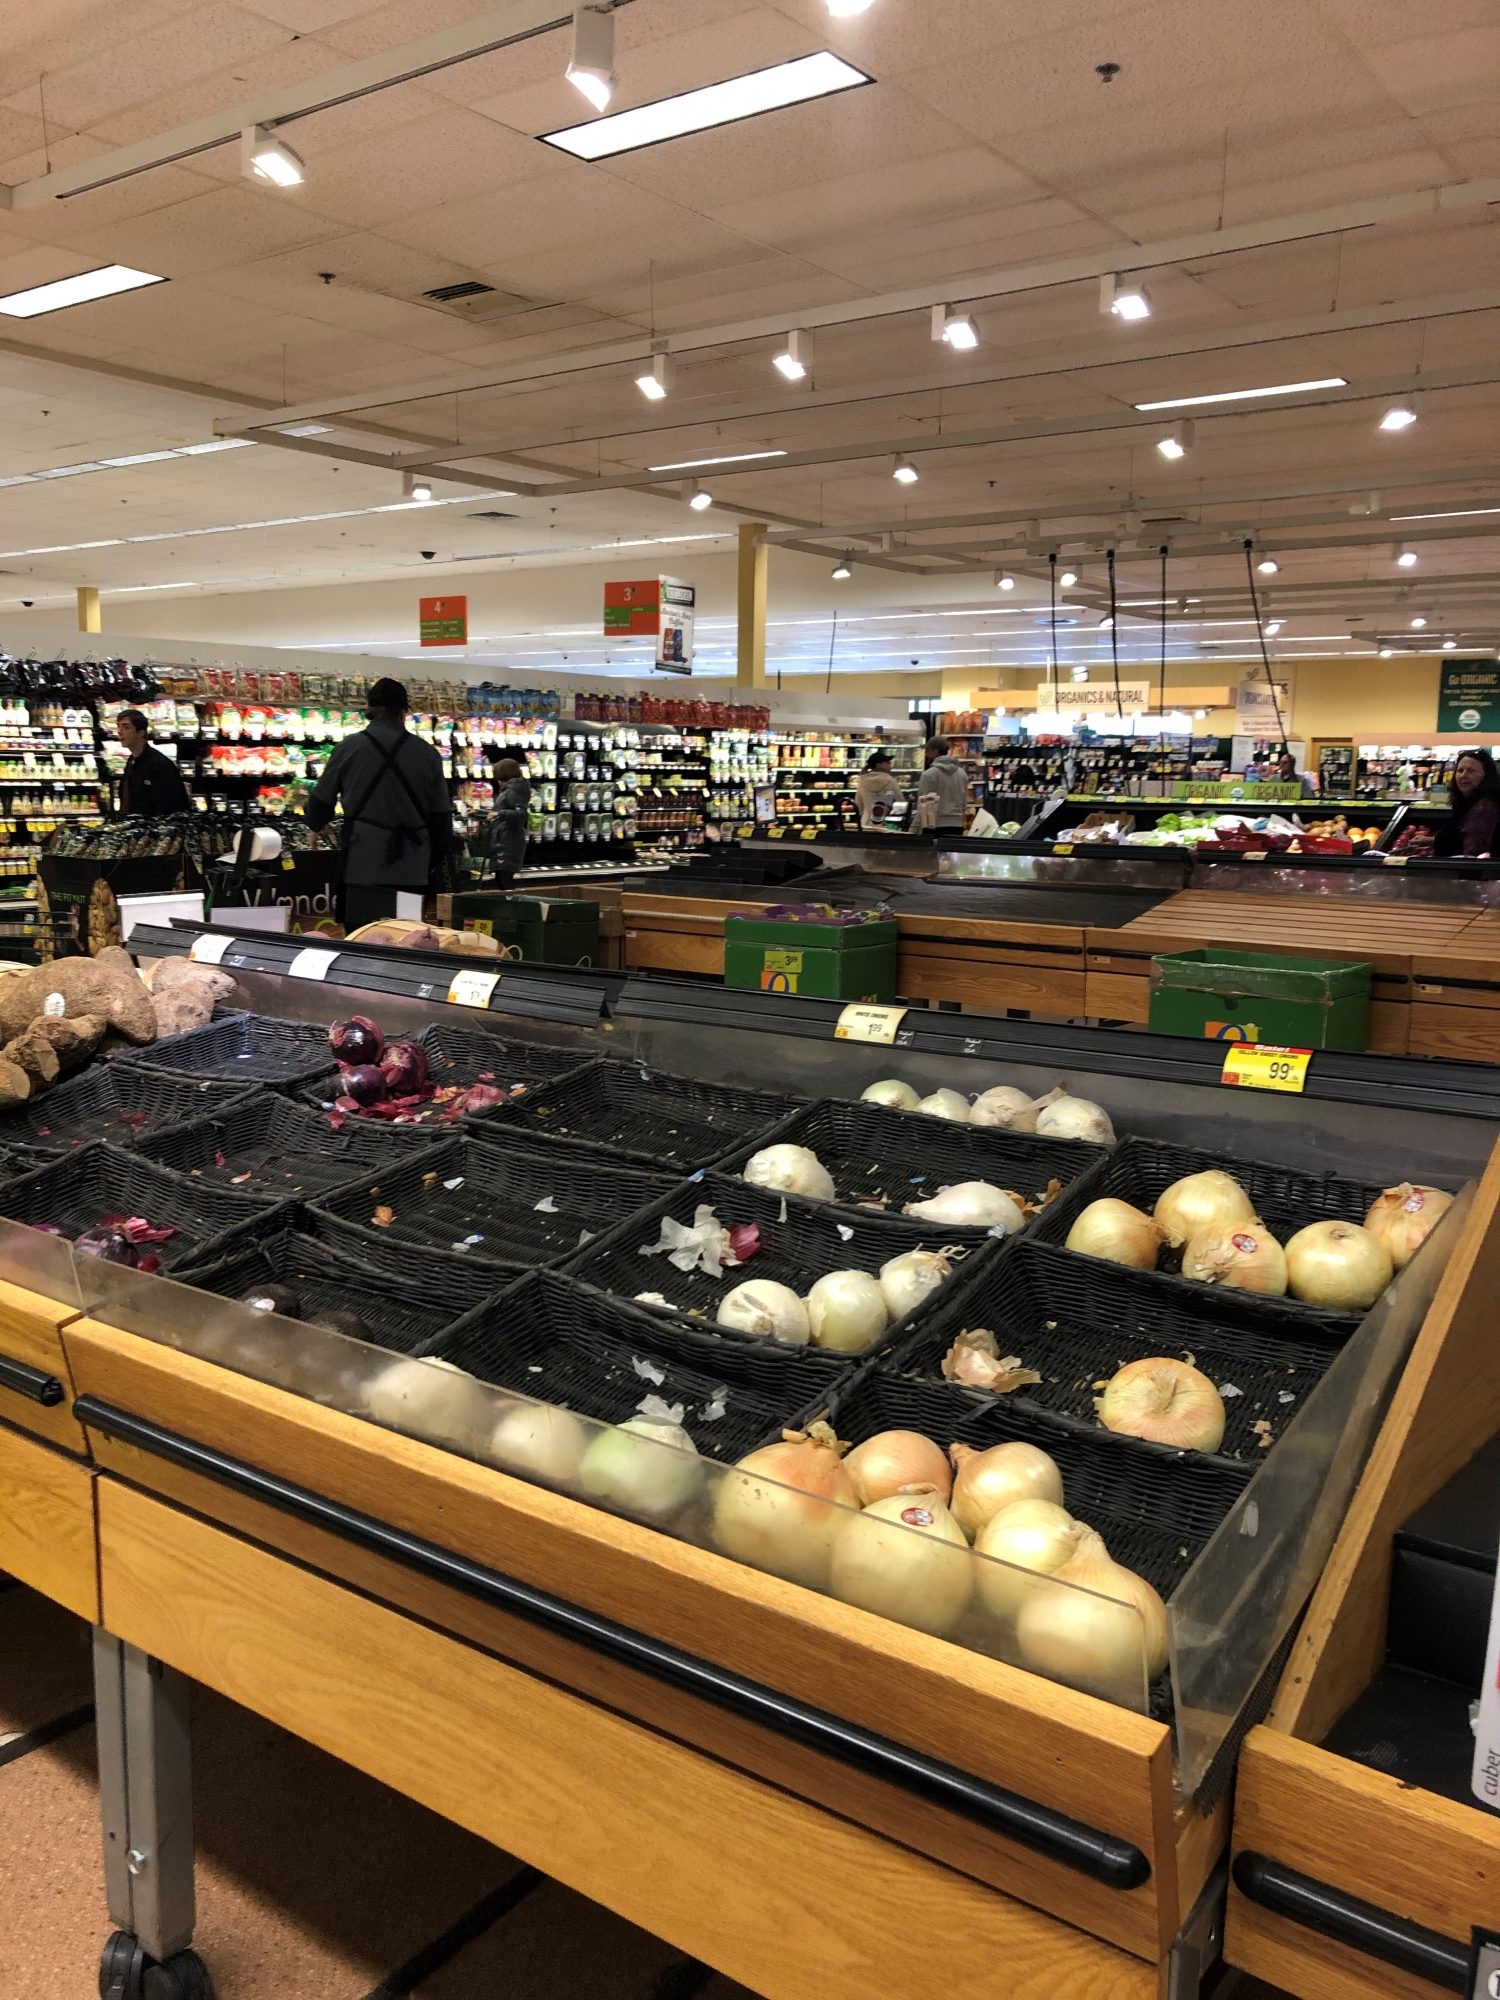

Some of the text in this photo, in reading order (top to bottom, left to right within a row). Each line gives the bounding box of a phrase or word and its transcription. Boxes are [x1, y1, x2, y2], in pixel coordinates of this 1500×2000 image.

[624, 587, 632, 601] 3
[1056, 691, 1097, 704] ORGANICS
[1106, 690, 1144, 703] NATURAL
[1254, 1044, 1290, 1053] Sale!
